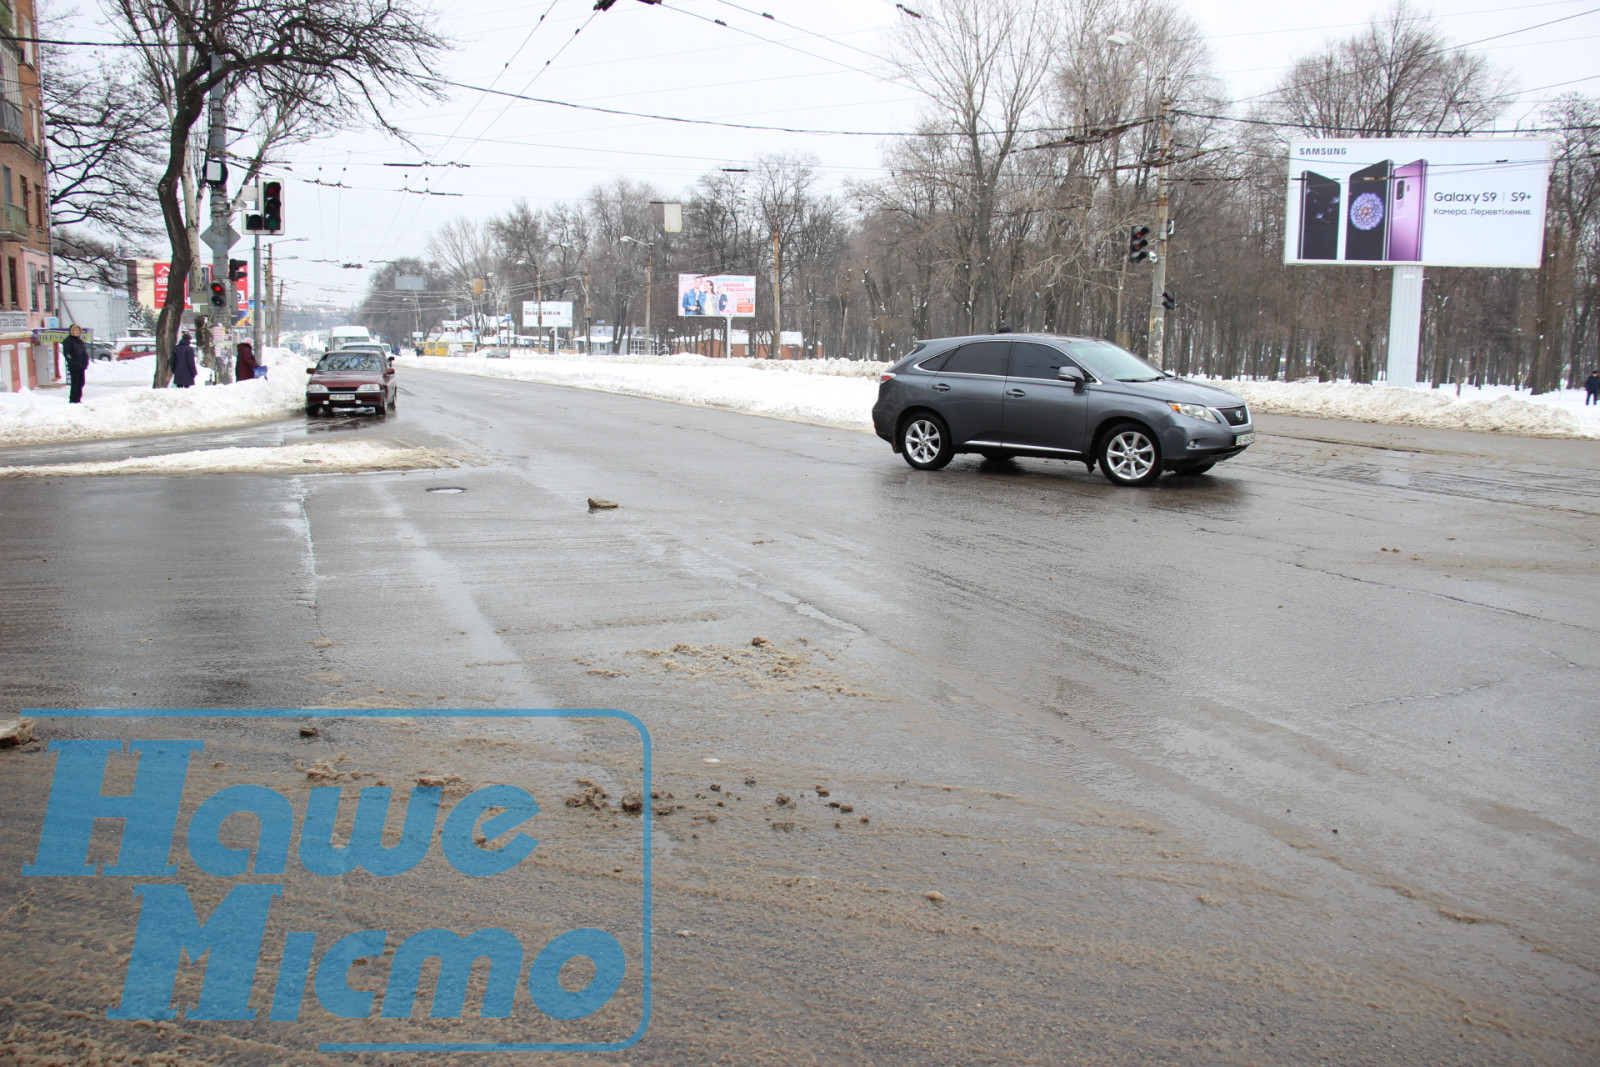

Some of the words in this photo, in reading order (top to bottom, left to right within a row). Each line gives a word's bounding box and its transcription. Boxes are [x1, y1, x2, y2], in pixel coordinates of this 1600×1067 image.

[1299, 147, 1347, 156] SAMSUNG
[1433, 191, 1480, 205] Galaxy
[1482, 191, 1497, 203] S9
[1511, 191, 1532, 203] S9+
